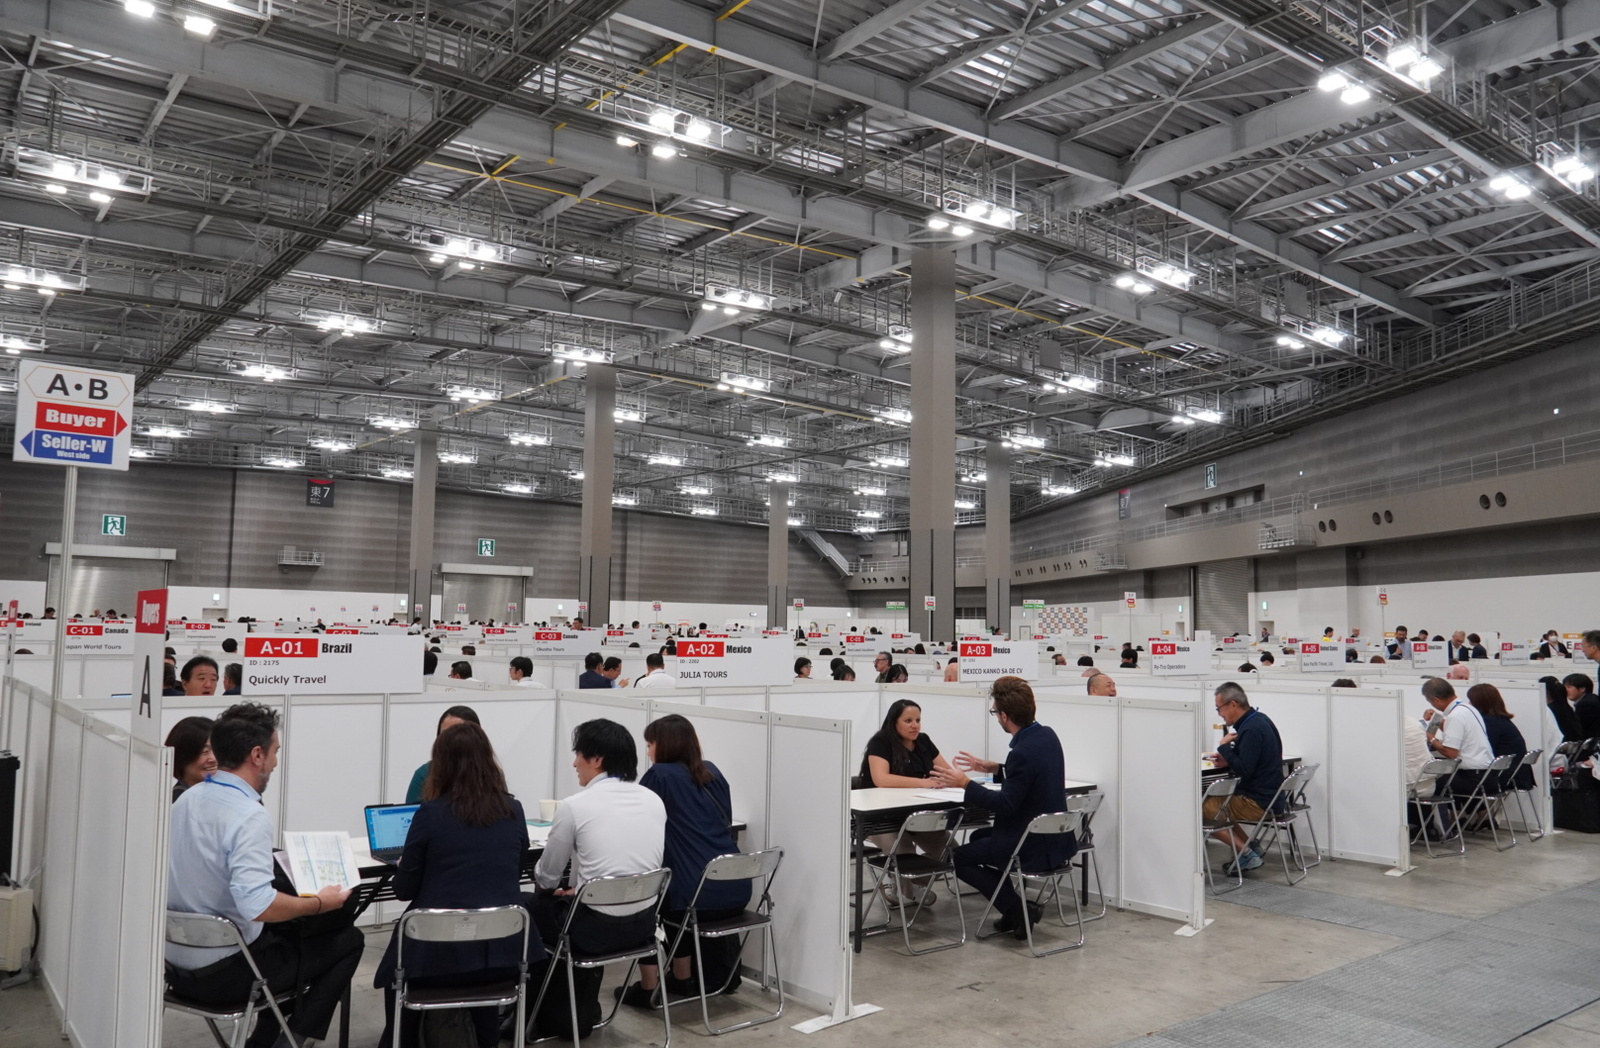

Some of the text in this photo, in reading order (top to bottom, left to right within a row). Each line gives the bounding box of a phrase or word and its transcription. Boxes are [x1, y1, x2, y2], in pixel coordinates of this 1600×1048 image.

[45, 408, 106, 428] Buyer
[41, 433, 107, 453] Seller-W
[56, 450, 90, 460] West side
[70, 626, 94, 634] C-01
[260, 641, 352, 655] A-01 Brazil
[686, 644, 752, 655] A-02 Mexico
[966, 646, 986, 655] A-03
[1156, 645, 1172, 653] A-04
[248, 674, 327, 686] Quickly Travel
[139, 654, 151, 718] A
